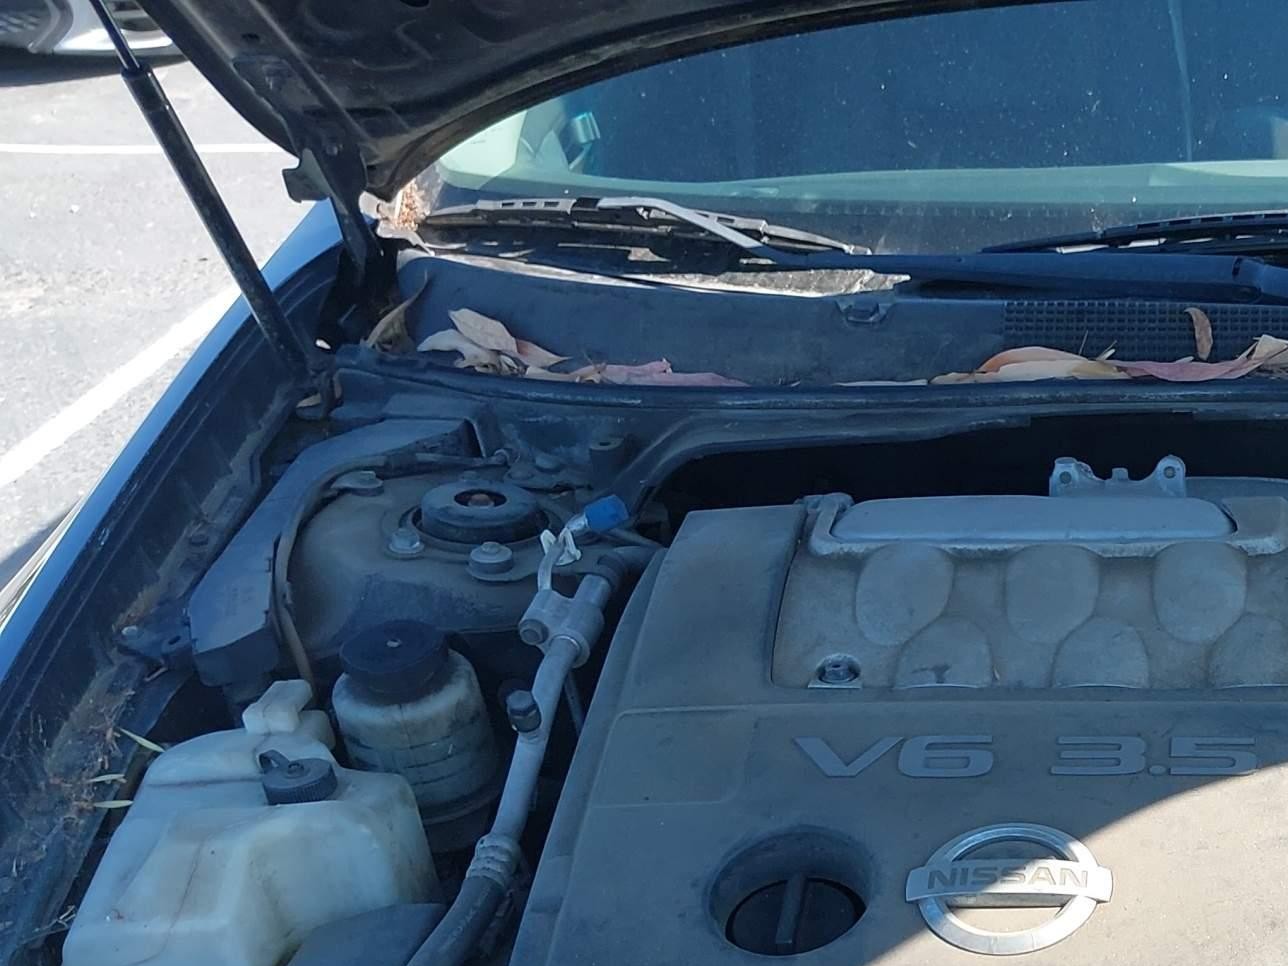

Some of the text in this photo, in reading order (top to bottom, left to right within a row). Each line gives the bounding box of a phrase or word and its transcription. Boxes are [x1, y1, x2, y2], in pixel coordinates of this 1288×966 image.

[793, 735, 1258, 778] V6 3.5
[927, 864, 1089, 890] NISSAN
